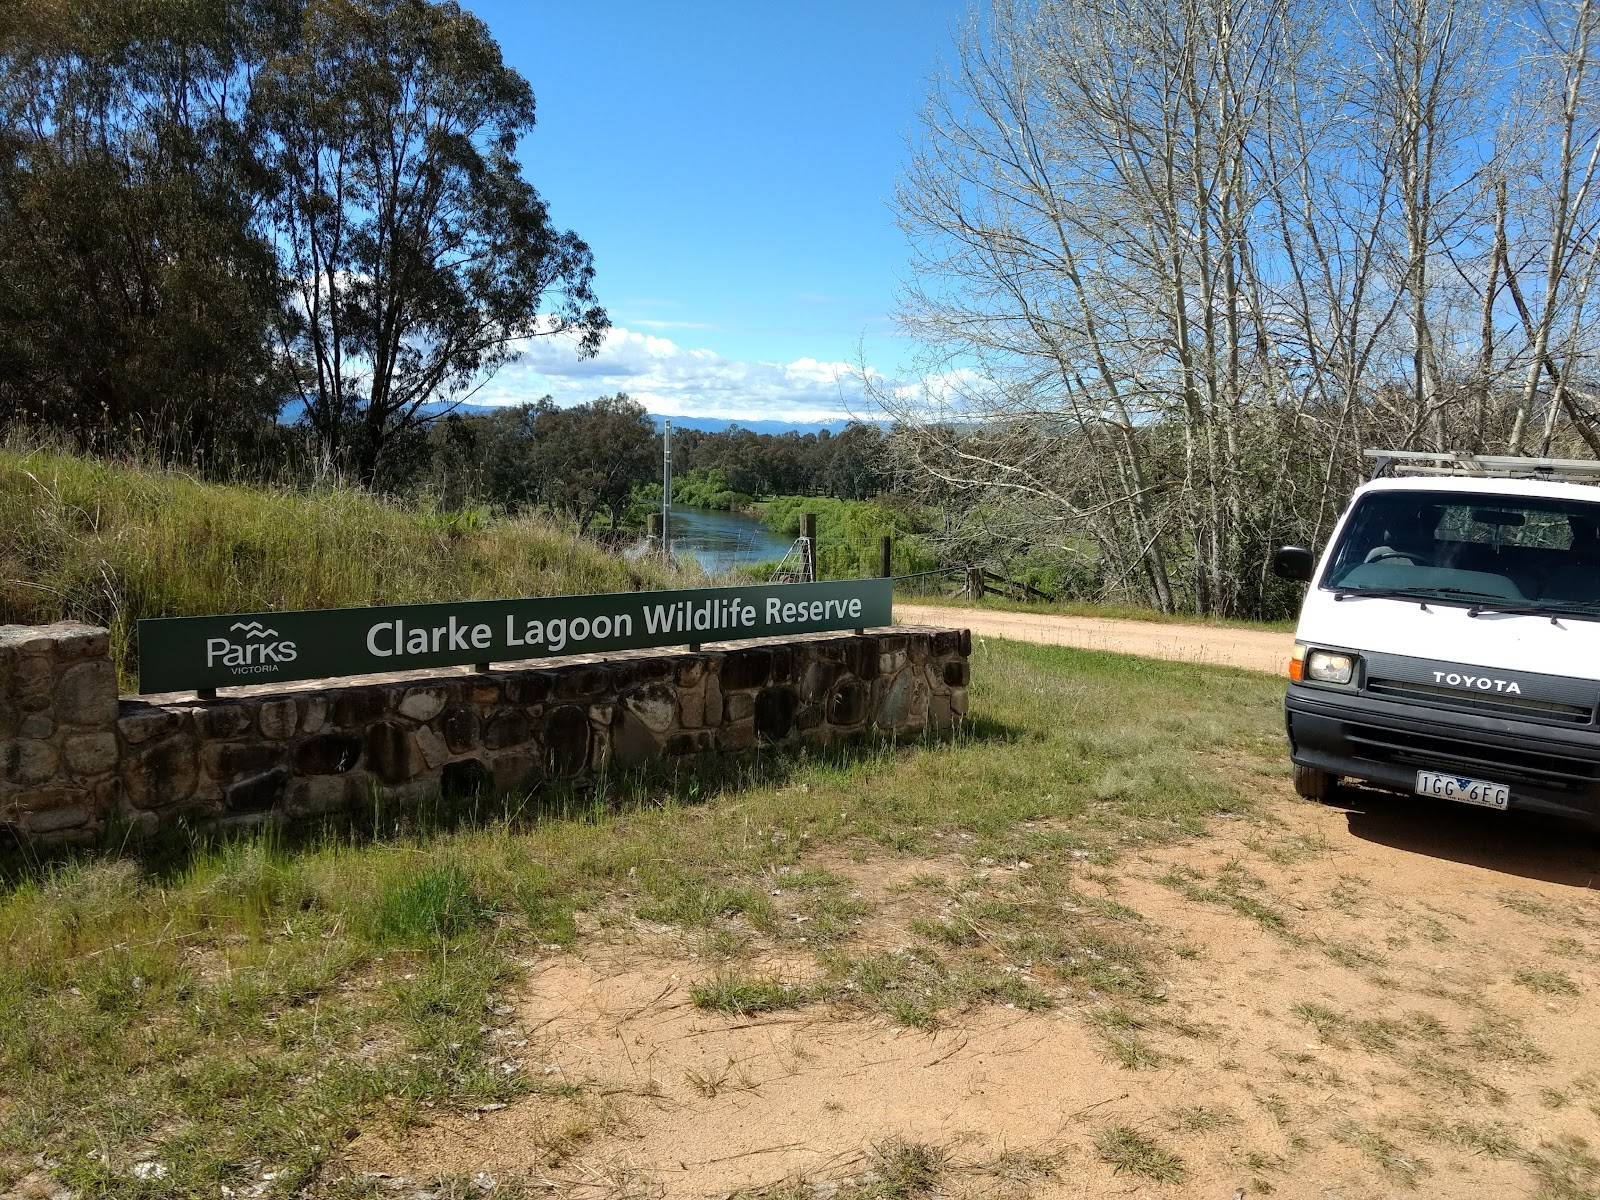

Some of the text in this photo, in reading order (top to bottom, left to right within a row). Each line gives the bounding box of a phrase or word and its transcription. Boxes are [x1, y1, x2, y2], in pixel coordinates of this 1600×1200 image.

[366, 597, 862, 657] Clarke Lagoon Wildlife Reserve
[207, 638, 297, 667] Parks
[231, 664, 279, 675] VICTORIA
[1433, 671, 1521, 694] TOYOTA
